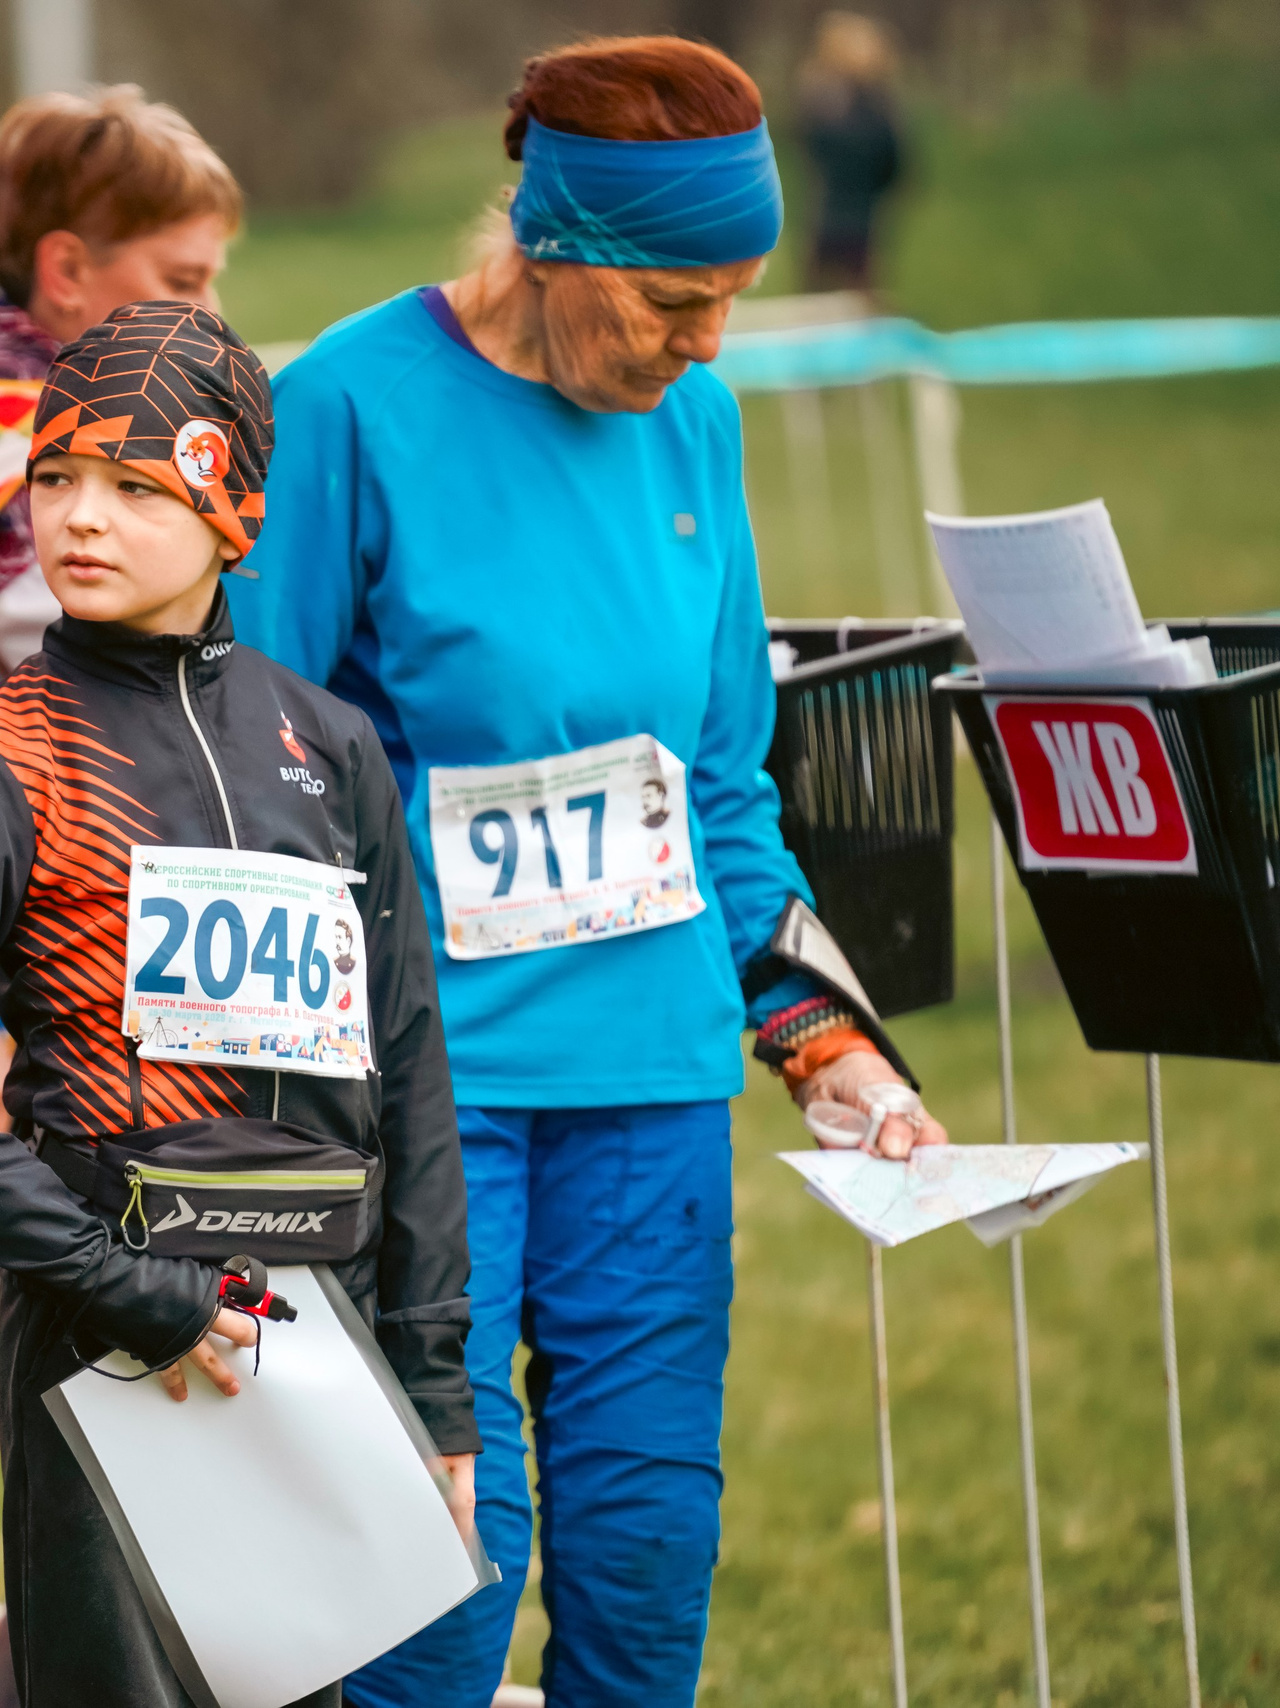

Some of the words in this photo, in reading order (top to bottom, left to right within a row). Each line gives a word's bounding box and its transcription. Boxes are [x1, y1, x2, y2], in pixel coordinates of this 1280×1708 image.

[1031, 720, 1158, 838] ЖВ
[469, 790, 606, 898] 917
[167, 879, 179, 888] ПО
[182, 880, 247, 892] СПОРТИВНОМУ
[224, 868, 278, 881] СПОРТИВНЫЕ
[134, 896, 330, 1010] 2046
[138, 996, 176, 1008] Памяти
[180, 1000, 226, 1012] военного
[230, 1004, 281, 1018] топографа
[284, 1007, 292, 1018] А.
[195, 1210, 332, 1233] DEMIX
